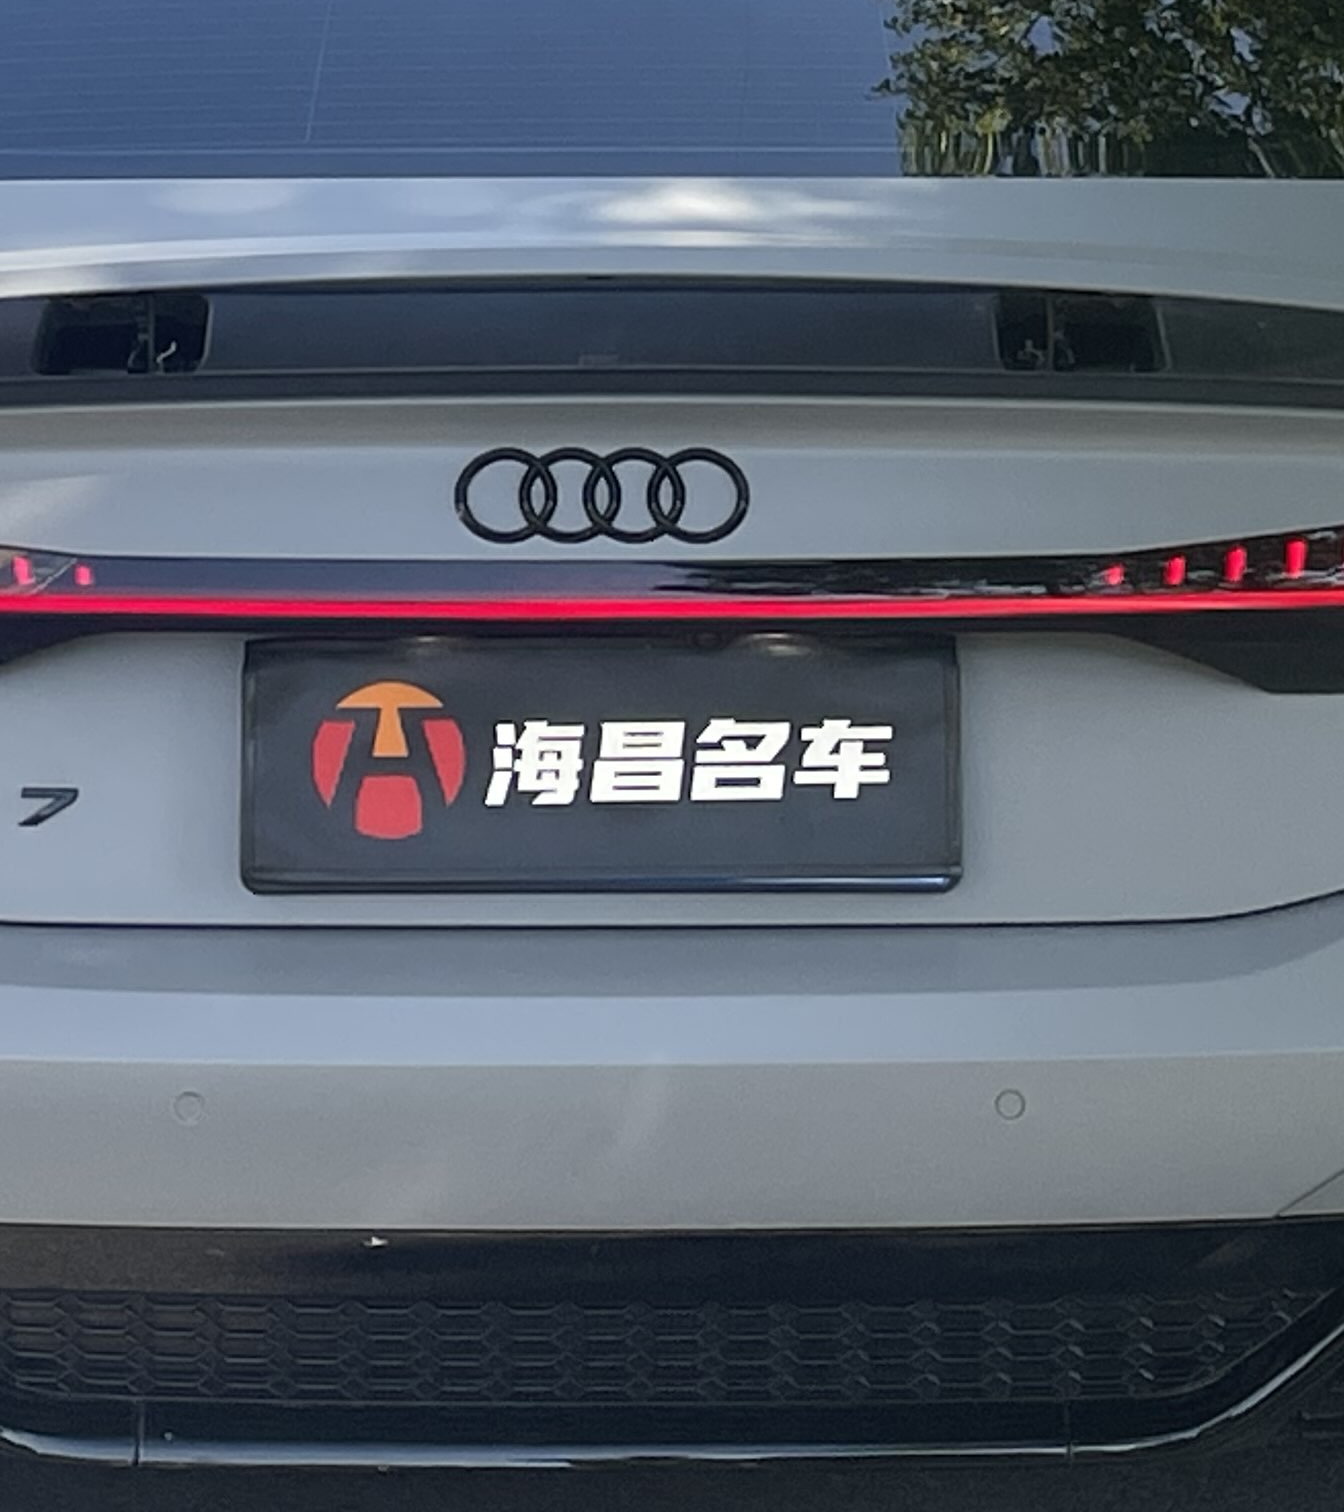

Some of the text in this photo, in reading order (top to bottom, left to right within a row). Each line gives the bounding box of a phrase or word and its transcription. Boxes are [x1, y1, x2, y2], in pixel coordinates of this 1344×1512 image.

[485, 718, 894, 807] 海昌名车
[17, 786, 80, 828] 7
